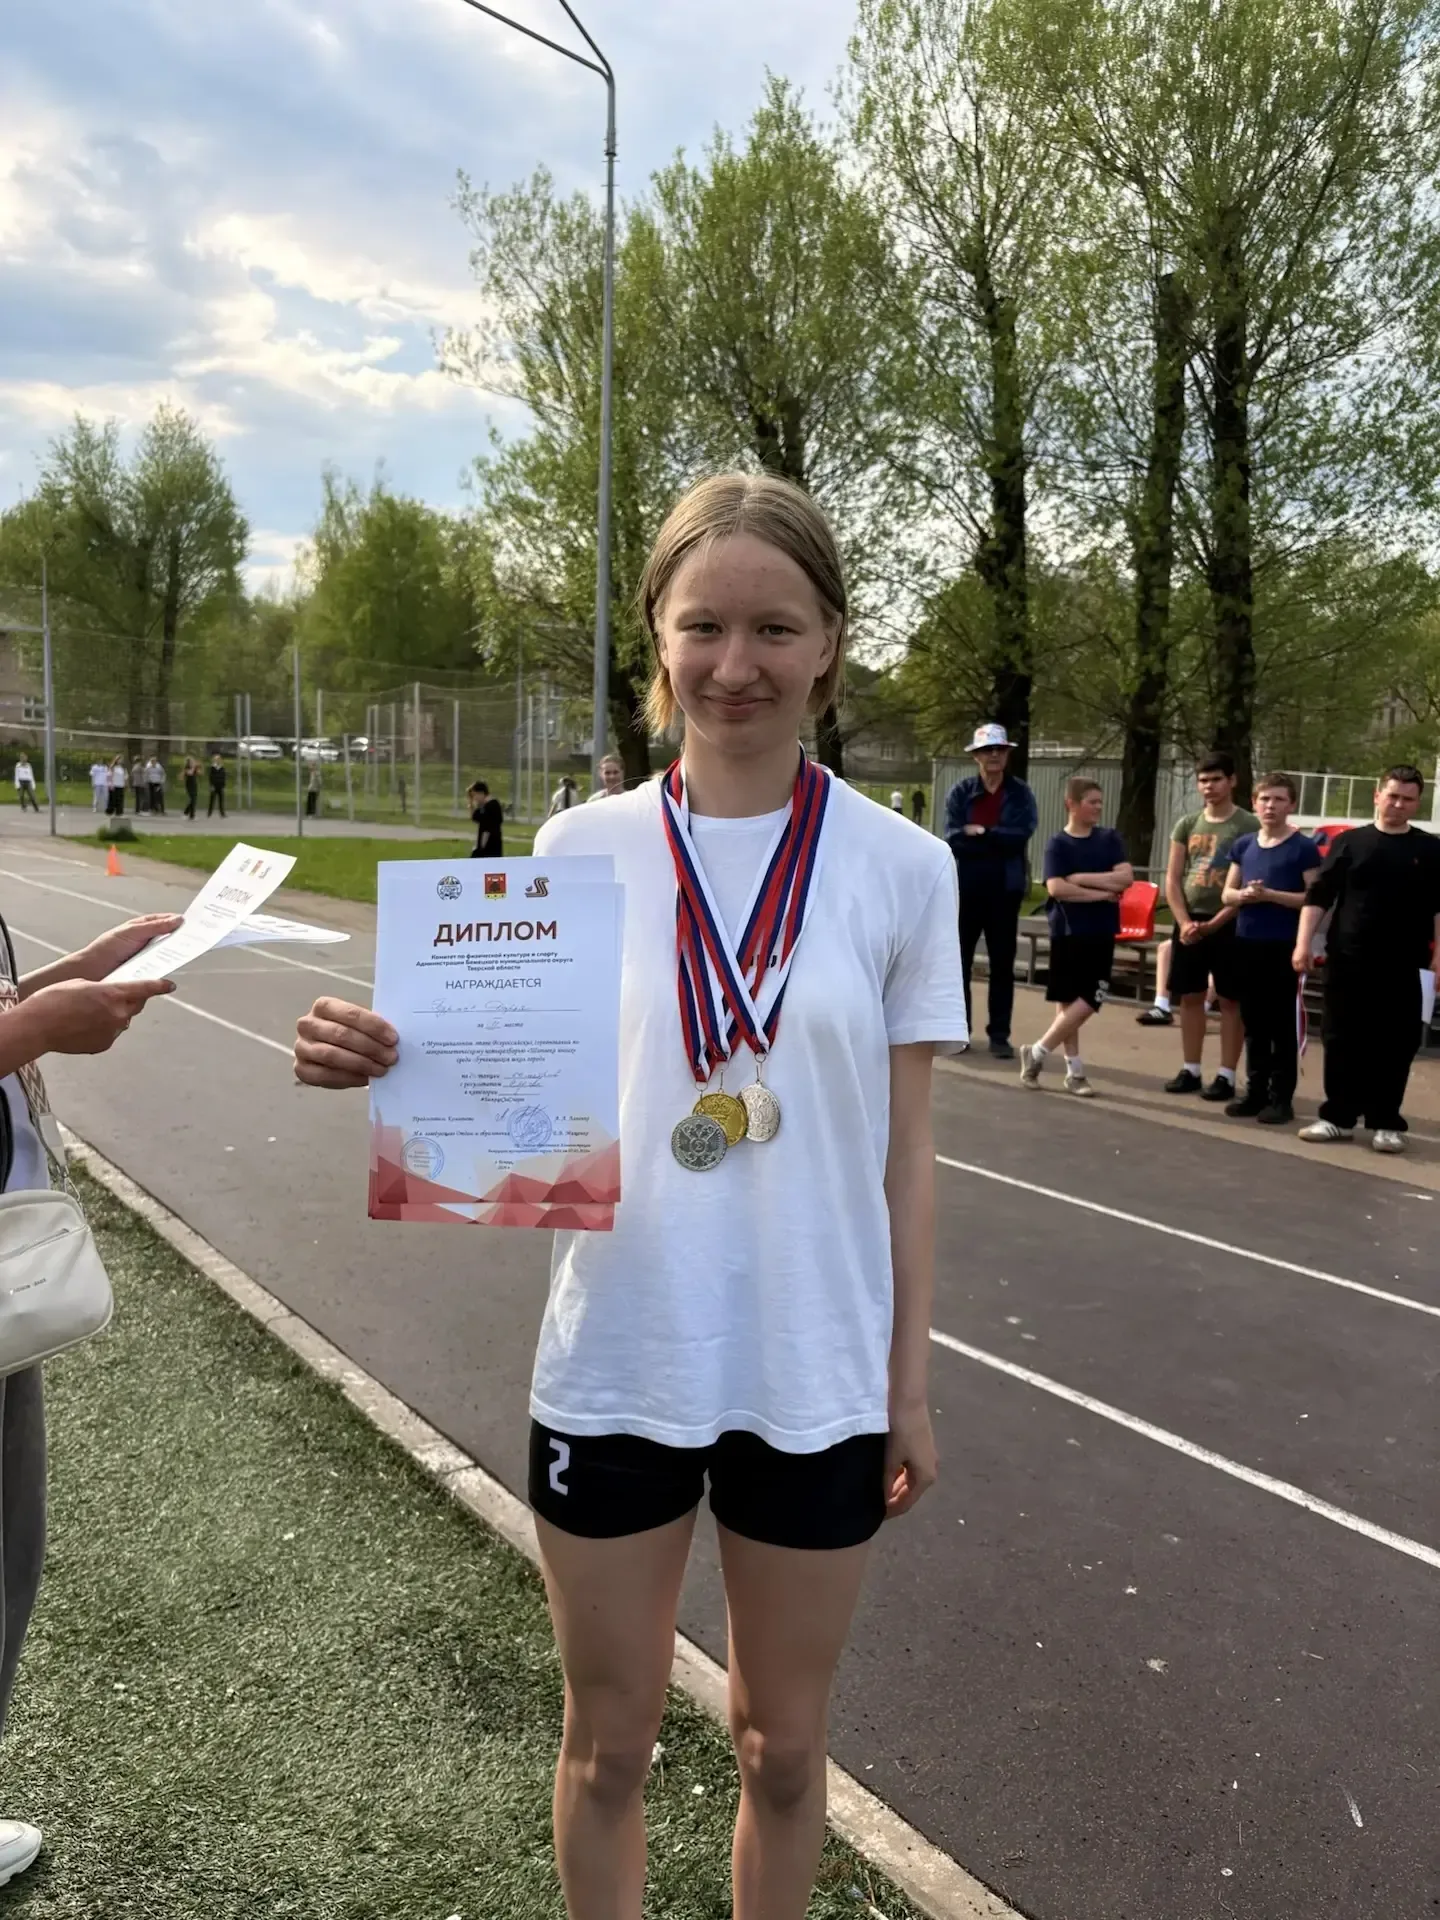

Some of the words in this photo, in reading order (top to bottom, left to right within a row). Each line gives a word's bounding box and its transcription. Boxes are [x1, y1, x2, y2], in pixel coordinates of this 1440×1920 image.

[433, 920, 557, 947] ДИПЛОМ
[445, 978, 542, 990] НАГРАЖДАЕТСЯ
[548, 1436, 571, 1497] 2
